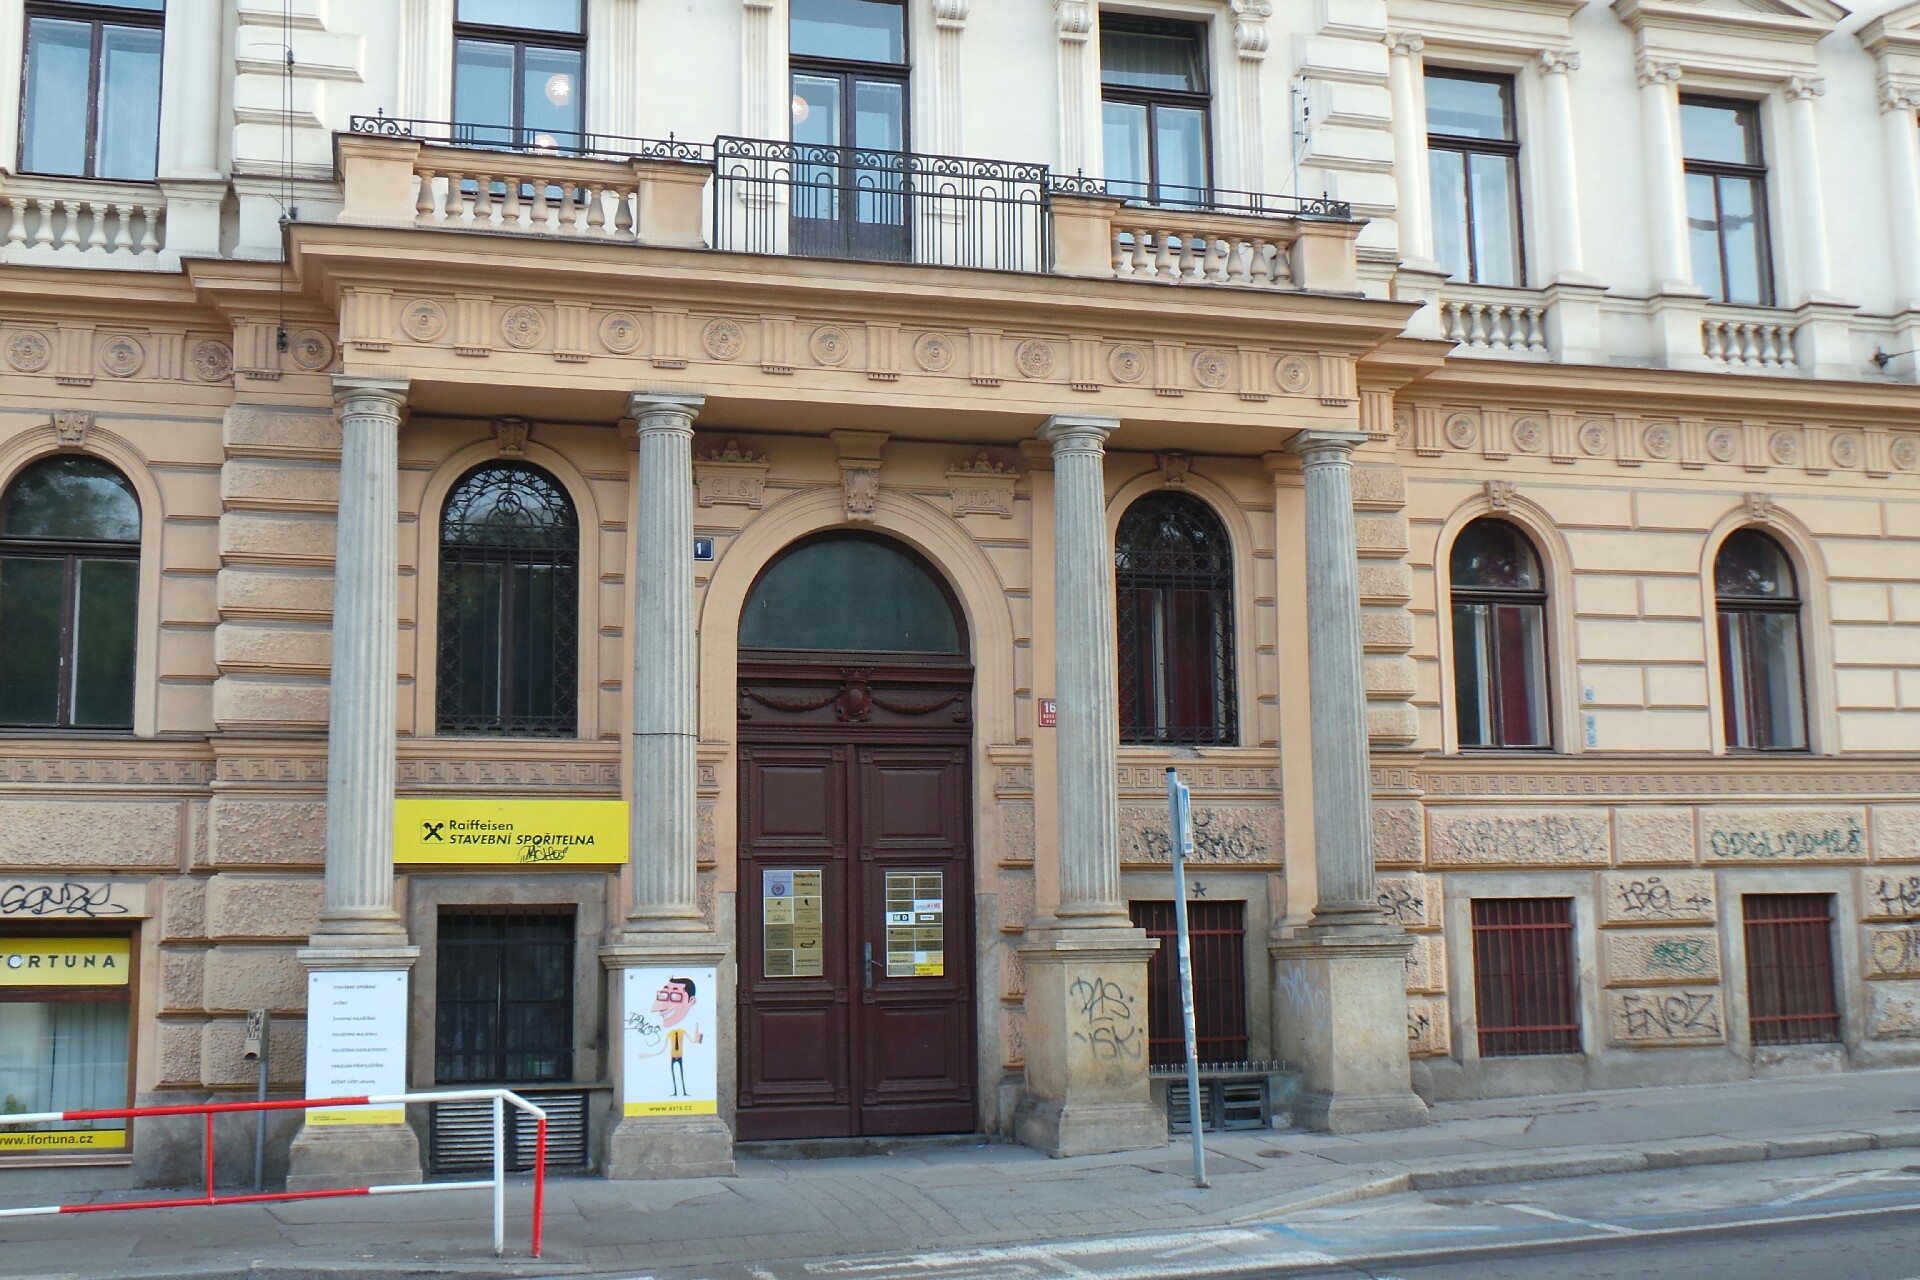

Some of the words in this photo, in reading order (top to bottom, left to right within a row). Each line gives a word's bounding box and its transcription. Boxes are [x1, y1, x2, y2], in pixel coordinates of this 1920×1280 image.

[449, 819, 514, 831] Raiffeisen
[449, 832, 513, 845] STAVEBNÍ
[515, 832, 595, 845] SPOŘITELNA
[0, 954, 116, 969] ORTUNA
